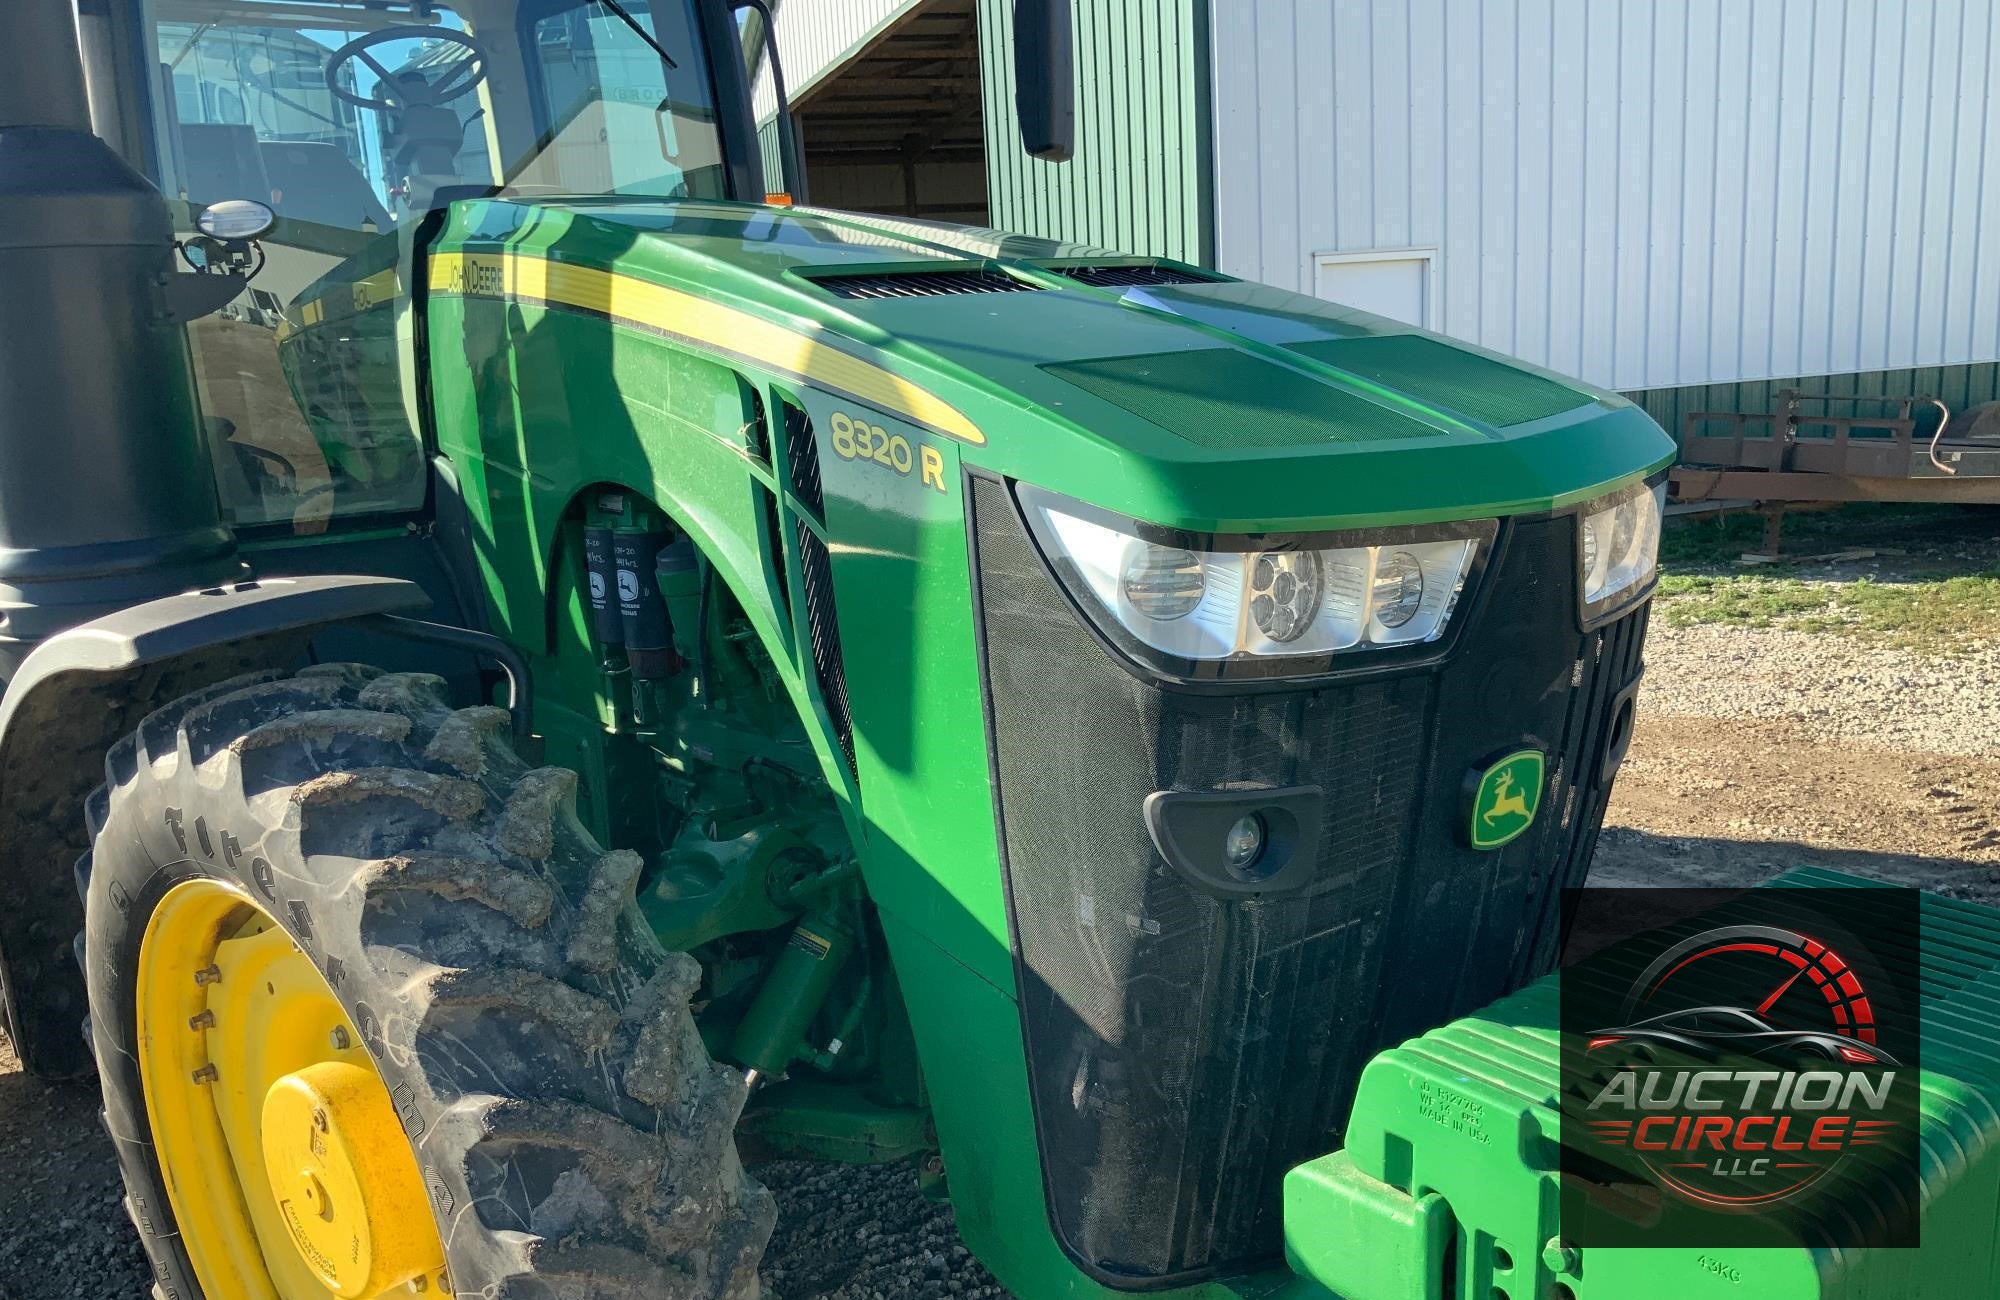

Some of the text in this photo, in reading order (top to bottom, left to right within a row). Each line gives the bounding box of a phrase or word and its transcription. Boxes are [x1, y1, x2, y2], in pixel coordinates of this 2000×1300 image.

[448, 259, 504, 293] JOHN DEERE
[829, 410, 949, 495] 8320 R
[1419, 1105, 1449, 1128] MADE
[1453, 1119, 1464, 1134] IN
[1469, 1126, 1492, 1147] USA
[1697, 1254, 1742, 1284] 43KG
